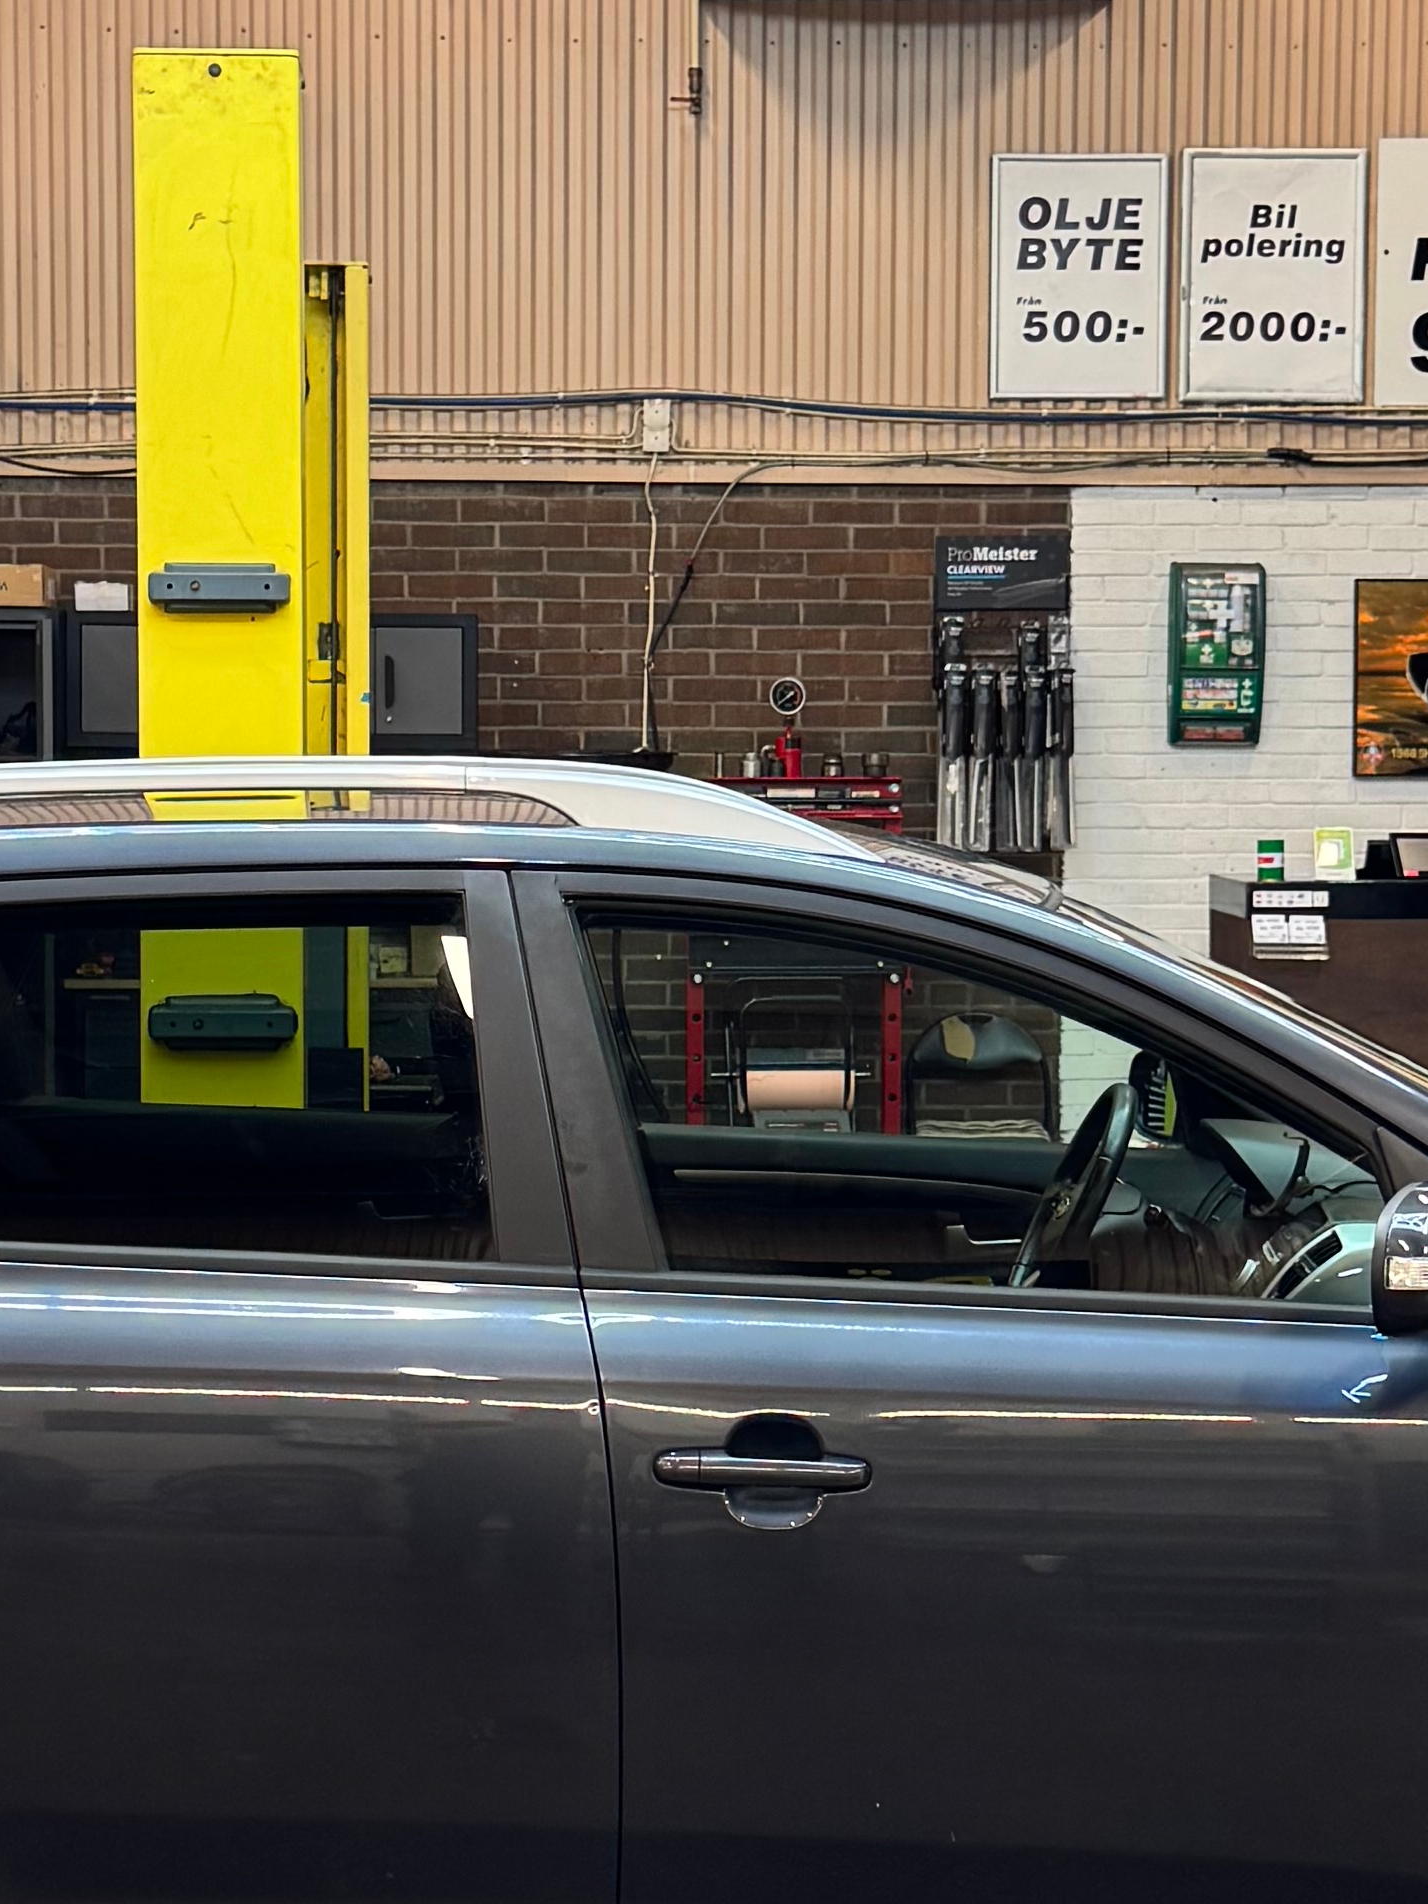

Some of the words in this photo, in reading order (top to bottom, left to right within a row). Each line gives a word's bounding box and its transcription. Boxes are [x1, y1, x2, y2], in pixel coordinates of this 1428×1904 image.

[1017, 196, 1143, 231] OLJE
[1249, 204, 1298, 229] Bil
[1016, 237, 1144, 271] BYTE
[1200, 233, 1346, 264] polering
[1022, 310, 1145, 343] 500:-
[1199, 311, 1347, 342] 2000:-
[947, 546, 1038, 562] ProMeister
[946, 565, 1006, 575] CLEARVIEW
